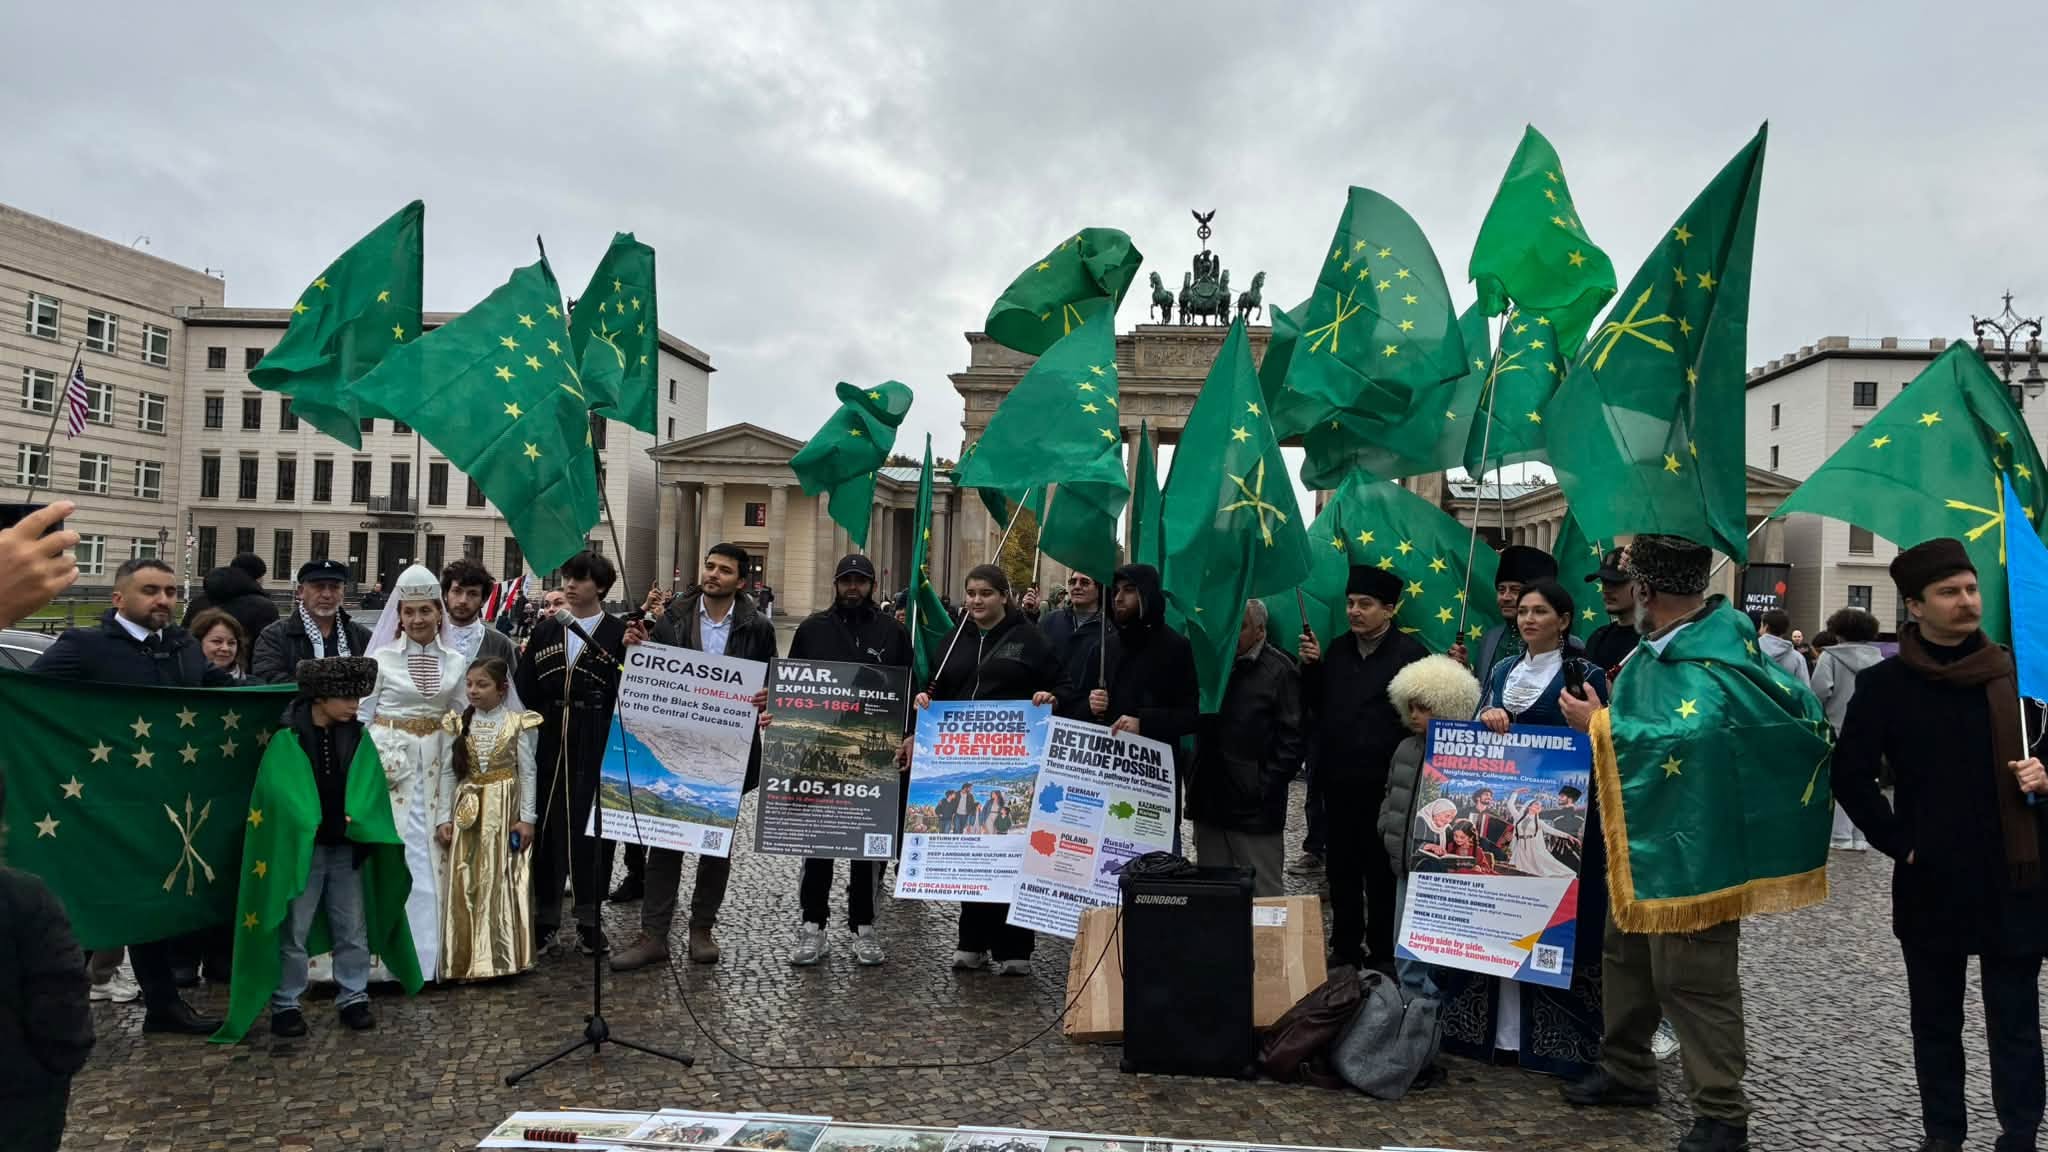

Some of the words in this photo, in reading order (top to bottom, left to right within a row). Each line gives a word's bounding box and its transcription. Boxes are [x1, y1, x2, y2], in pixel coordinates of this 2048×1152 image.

[1746, 594, 1776, 603] NICHT
[630, 652, 743, 685] CIRCASSIA
[777, 666, 838, 683] WAR.
[626, 674, 690, 692] HISTORICAL
[776, 684, 854, 697] EXPULSION.
[858, 689, 900, 701] EXILE.
[623, 688, 650, 700] From
[652, 693, 668, 704] the
[670, 696, 699, 710] Black
[702, 702, 720, 713] Sea
[723, 707, 752, 718] coast
[634, 701, 650, 712] the
[652, 705, 689, 719] Central
[691, 711, 744, 729] Caucasus.
[944, 710, 1024, 721] FREEDOM
[937, 722, 958, 732] TO
[962, 722, 1030, 733] CHOOSE.
[939, 733, 970, 744] THE
[974, 733, 1026, 744] RIGHT
[1052, 727, 1125, 757] RETURN
[1128, 744, 1162, 766] CAN
[1434, 728, 1476, 744] LIVES
[1478, 730, 1576, 751] WORLDWIDE.
[933, 744, 956, 756] TO
[958, 745, 1030, 756] RETURN.
[1434, 742, 1486, 758] ROOTS
[1488, 746, 1505, 760] IN
[1046, 760, 1064, 770] Three
[1066, 765, 1097, 777] examples.
[1104, 772, 1130, 784] pathway
[1130, 776, 1140, 784] for
[1049, 744, 1066, 760] BE
[1069, 748, 1110, 770] MADE
[1112, 757, 1172, 784] POSSIBLE.
[1432, 755, 1520, 774] CIRCASSIA.
[766, 778, 881, 799] 21.05.1864
[1067, 786, 1100, 798] GERMANY
[1060, 832, 1088, 844] POLAND
[1104, 838, 1134, 850] Russia?
[1442, 878, 1472, 886] EVERYDAY
[1020, 882, 1026, 890] A
[1027, 884, 1050, 896] RIGHT.
[1059, 891, 1099, 907] PRACTICAL
[1136, 894, 1188, 906] SOUNDBOKS
[1410, 931, 1434, 944] Living
[1436, 936, 1452, 946] side
[1454, 939, 1464, 949] by
[1466, 942, 1485, 952] side.
[1408, 940, 1440, 954] Carrying
[1446, 946, 1490, 962] little-known
[1491, 954, 1521, 968] history.
